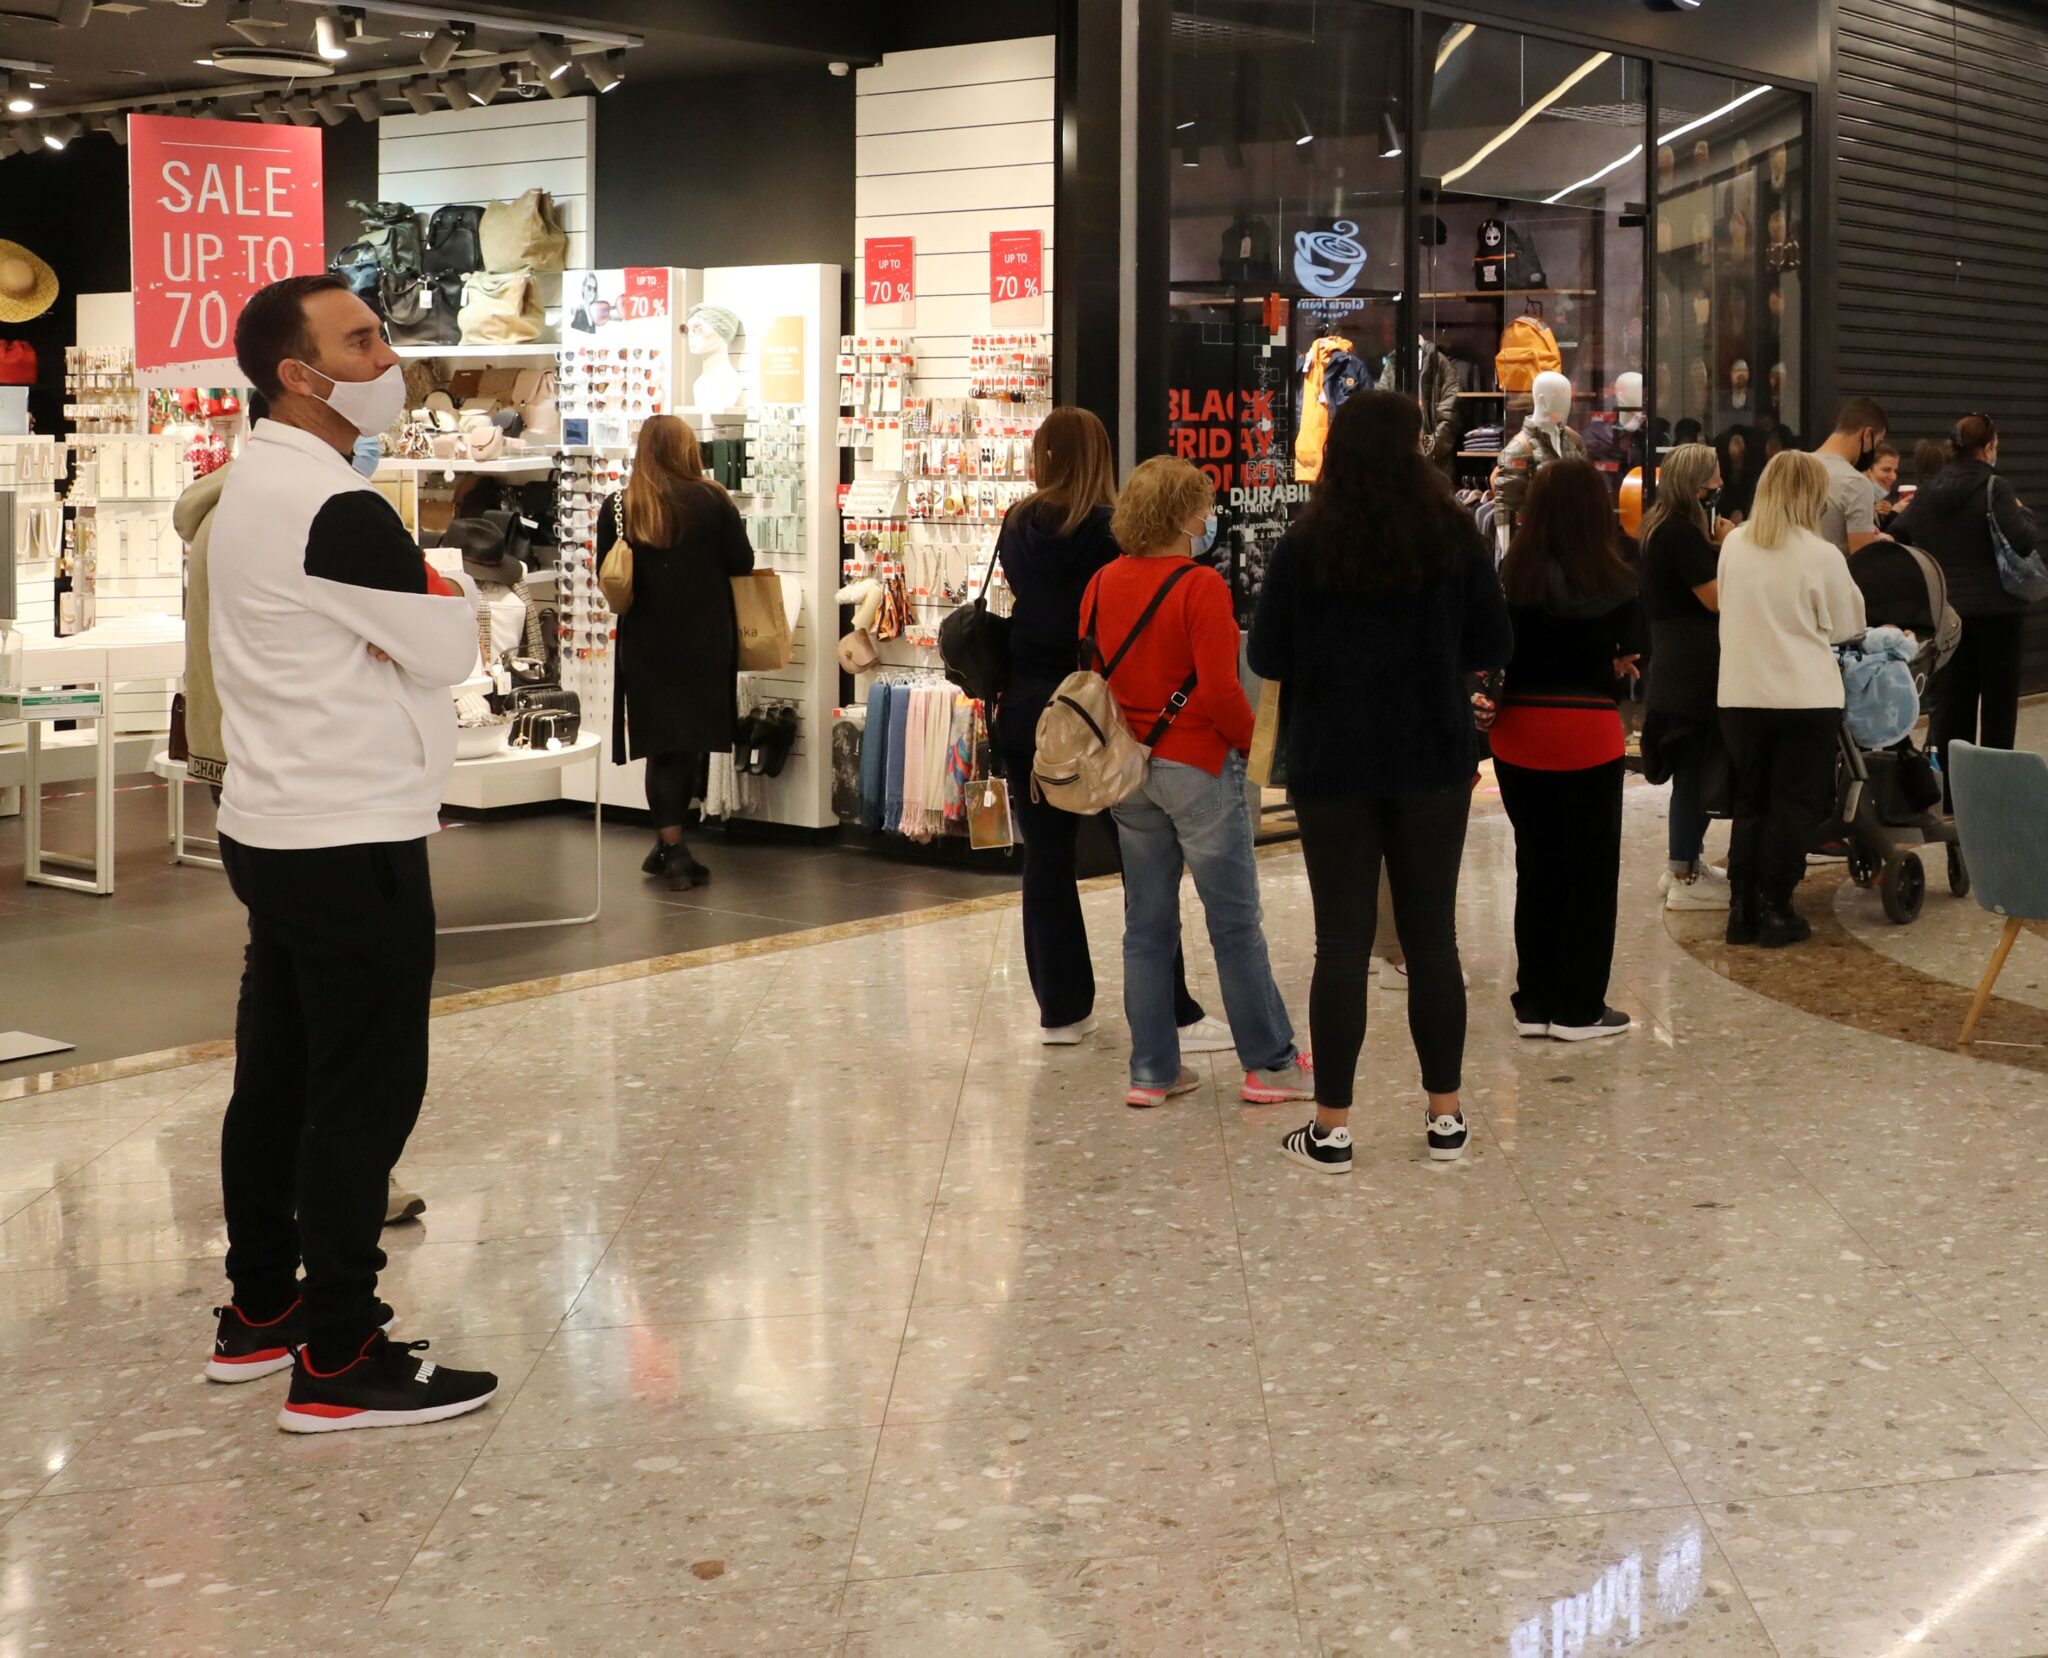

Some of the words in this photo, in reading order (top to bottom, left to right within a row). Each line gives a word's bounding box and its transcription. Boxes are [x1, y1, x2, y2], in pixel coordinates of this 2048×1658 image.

[160, 160, 293, 218] SALE
[162, 232, 224, 283] UP
[238, 234, 294, 284] TO
[878, 259, 889, 269] UP
[890, 259, 901, 269] TO
[1004, 253, 1015, 264] UP
[1016, 252, 1028, 263] TO
[636, 275, 647, 286] UP
[646, 275, 657, 286] TO
[870, 280, 892, 303] 70
[897, 282, 911, 302] %
[995, 275, 1018, 298] 70
[1024, 277, 1038, 298] %
[629, 295, 649, 317] 70
[653, 298, 665, 316] %
[165, 291, 228, 349] 70
